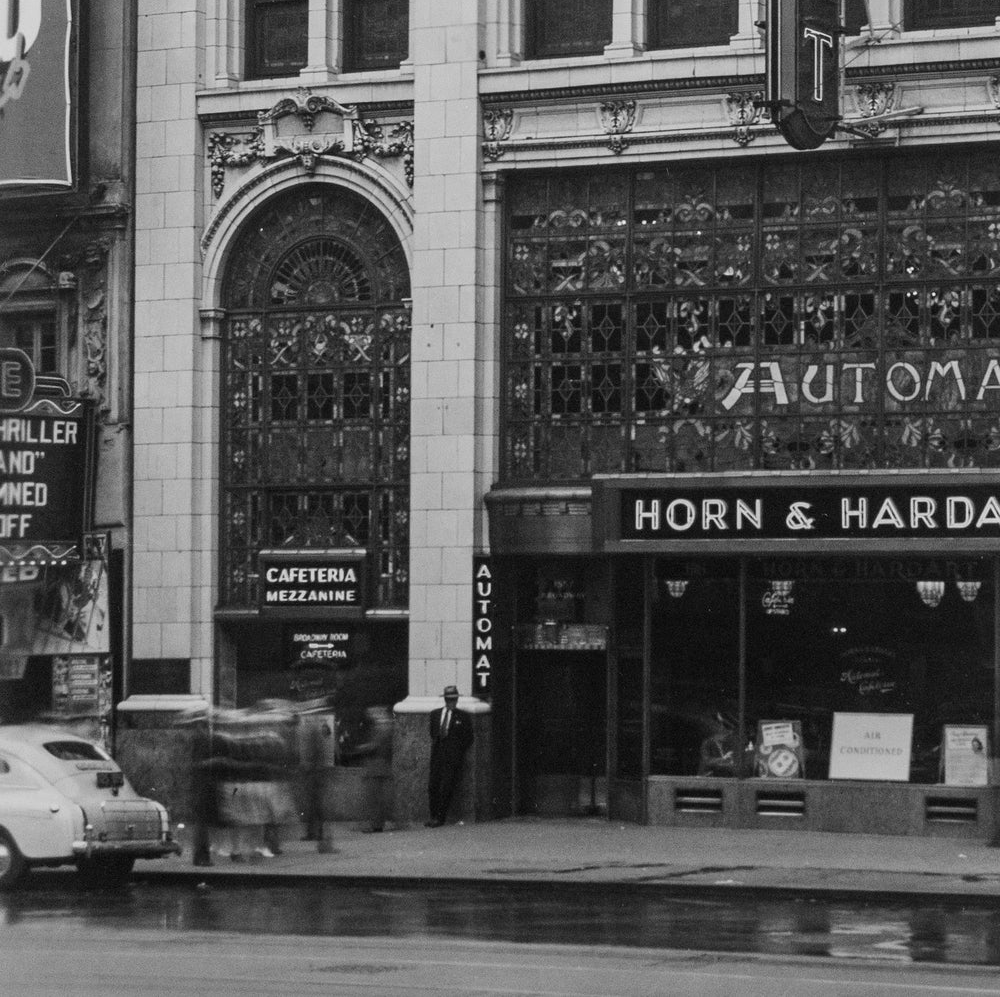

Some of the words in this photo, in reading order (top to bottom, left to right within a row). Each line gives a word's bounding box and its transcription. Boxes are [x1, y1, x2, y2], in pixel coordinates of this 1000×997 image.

[634, 498, 763, 531] HORN
[785, 501, 816, 531] &
[266, 567, 357, 583] CAFETERIA
[266, 589, 356, 602] MEZZANINE
[475, 563, 493, 688] AUTOMAT
[300, 649, 347, 659] CAFETERIA
[864, 731, 882, 740] AIR
[839, 745, 904, 756] CONDITIONED
